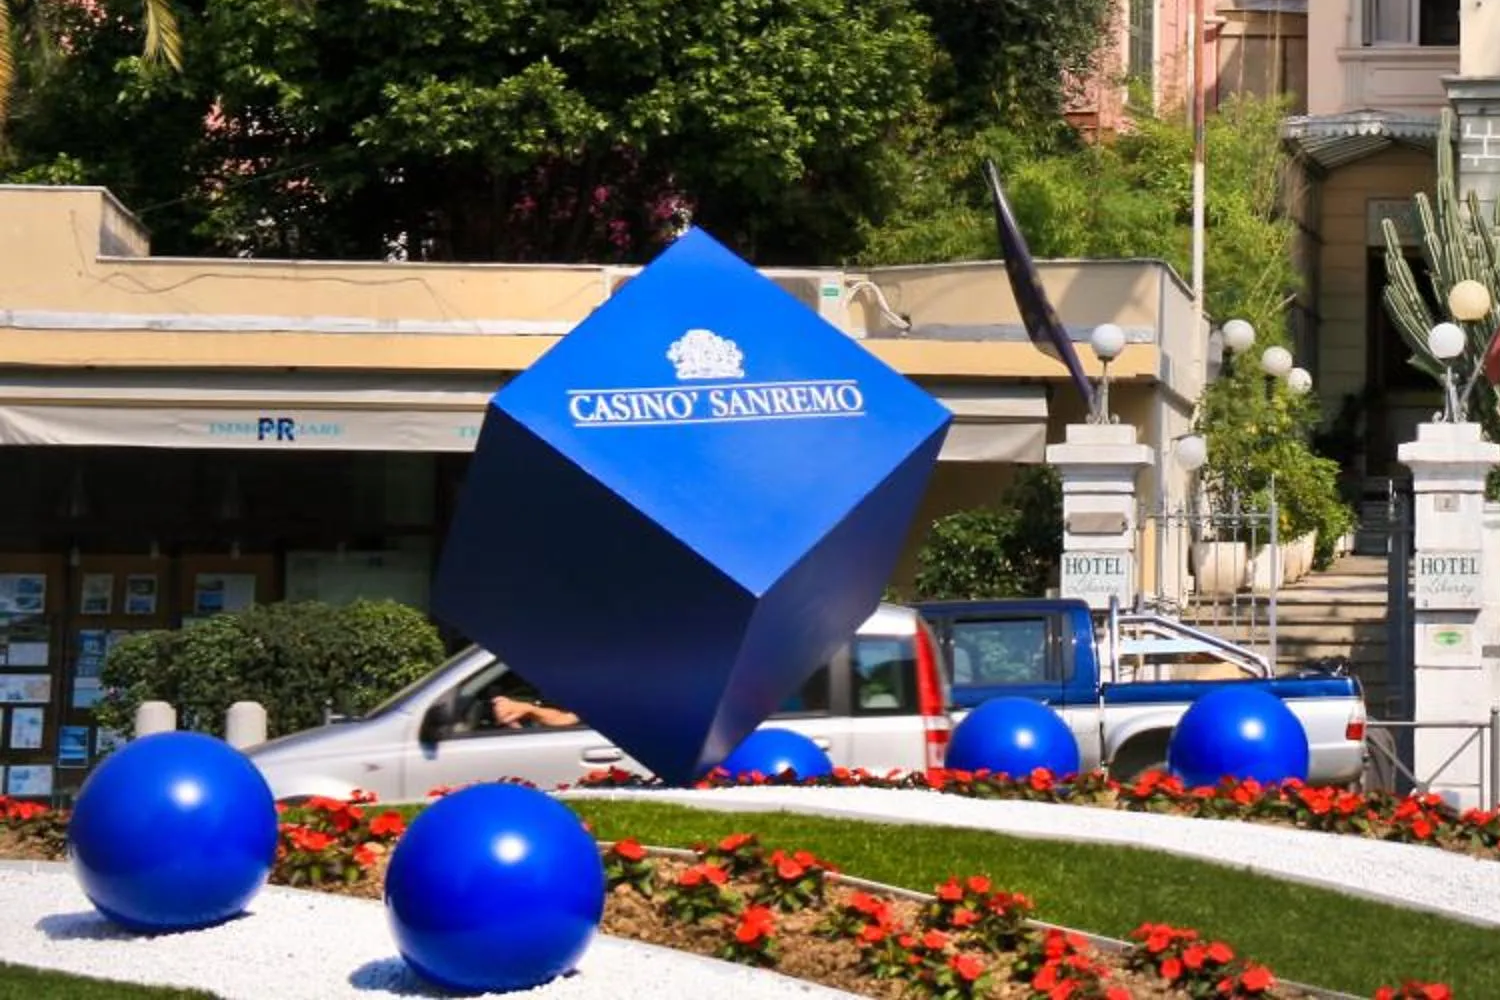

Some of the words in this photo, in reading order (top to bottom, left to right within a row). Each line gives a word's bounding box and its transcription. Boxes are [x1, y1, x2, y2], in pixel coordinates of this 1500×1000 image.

[709, 385, 864, 416] SANREMO
[257, 417, 296, 441] PR
[1065, 557, 1125, 575] HOTEL
[1420, 557, 1480, 575] HOTEL
